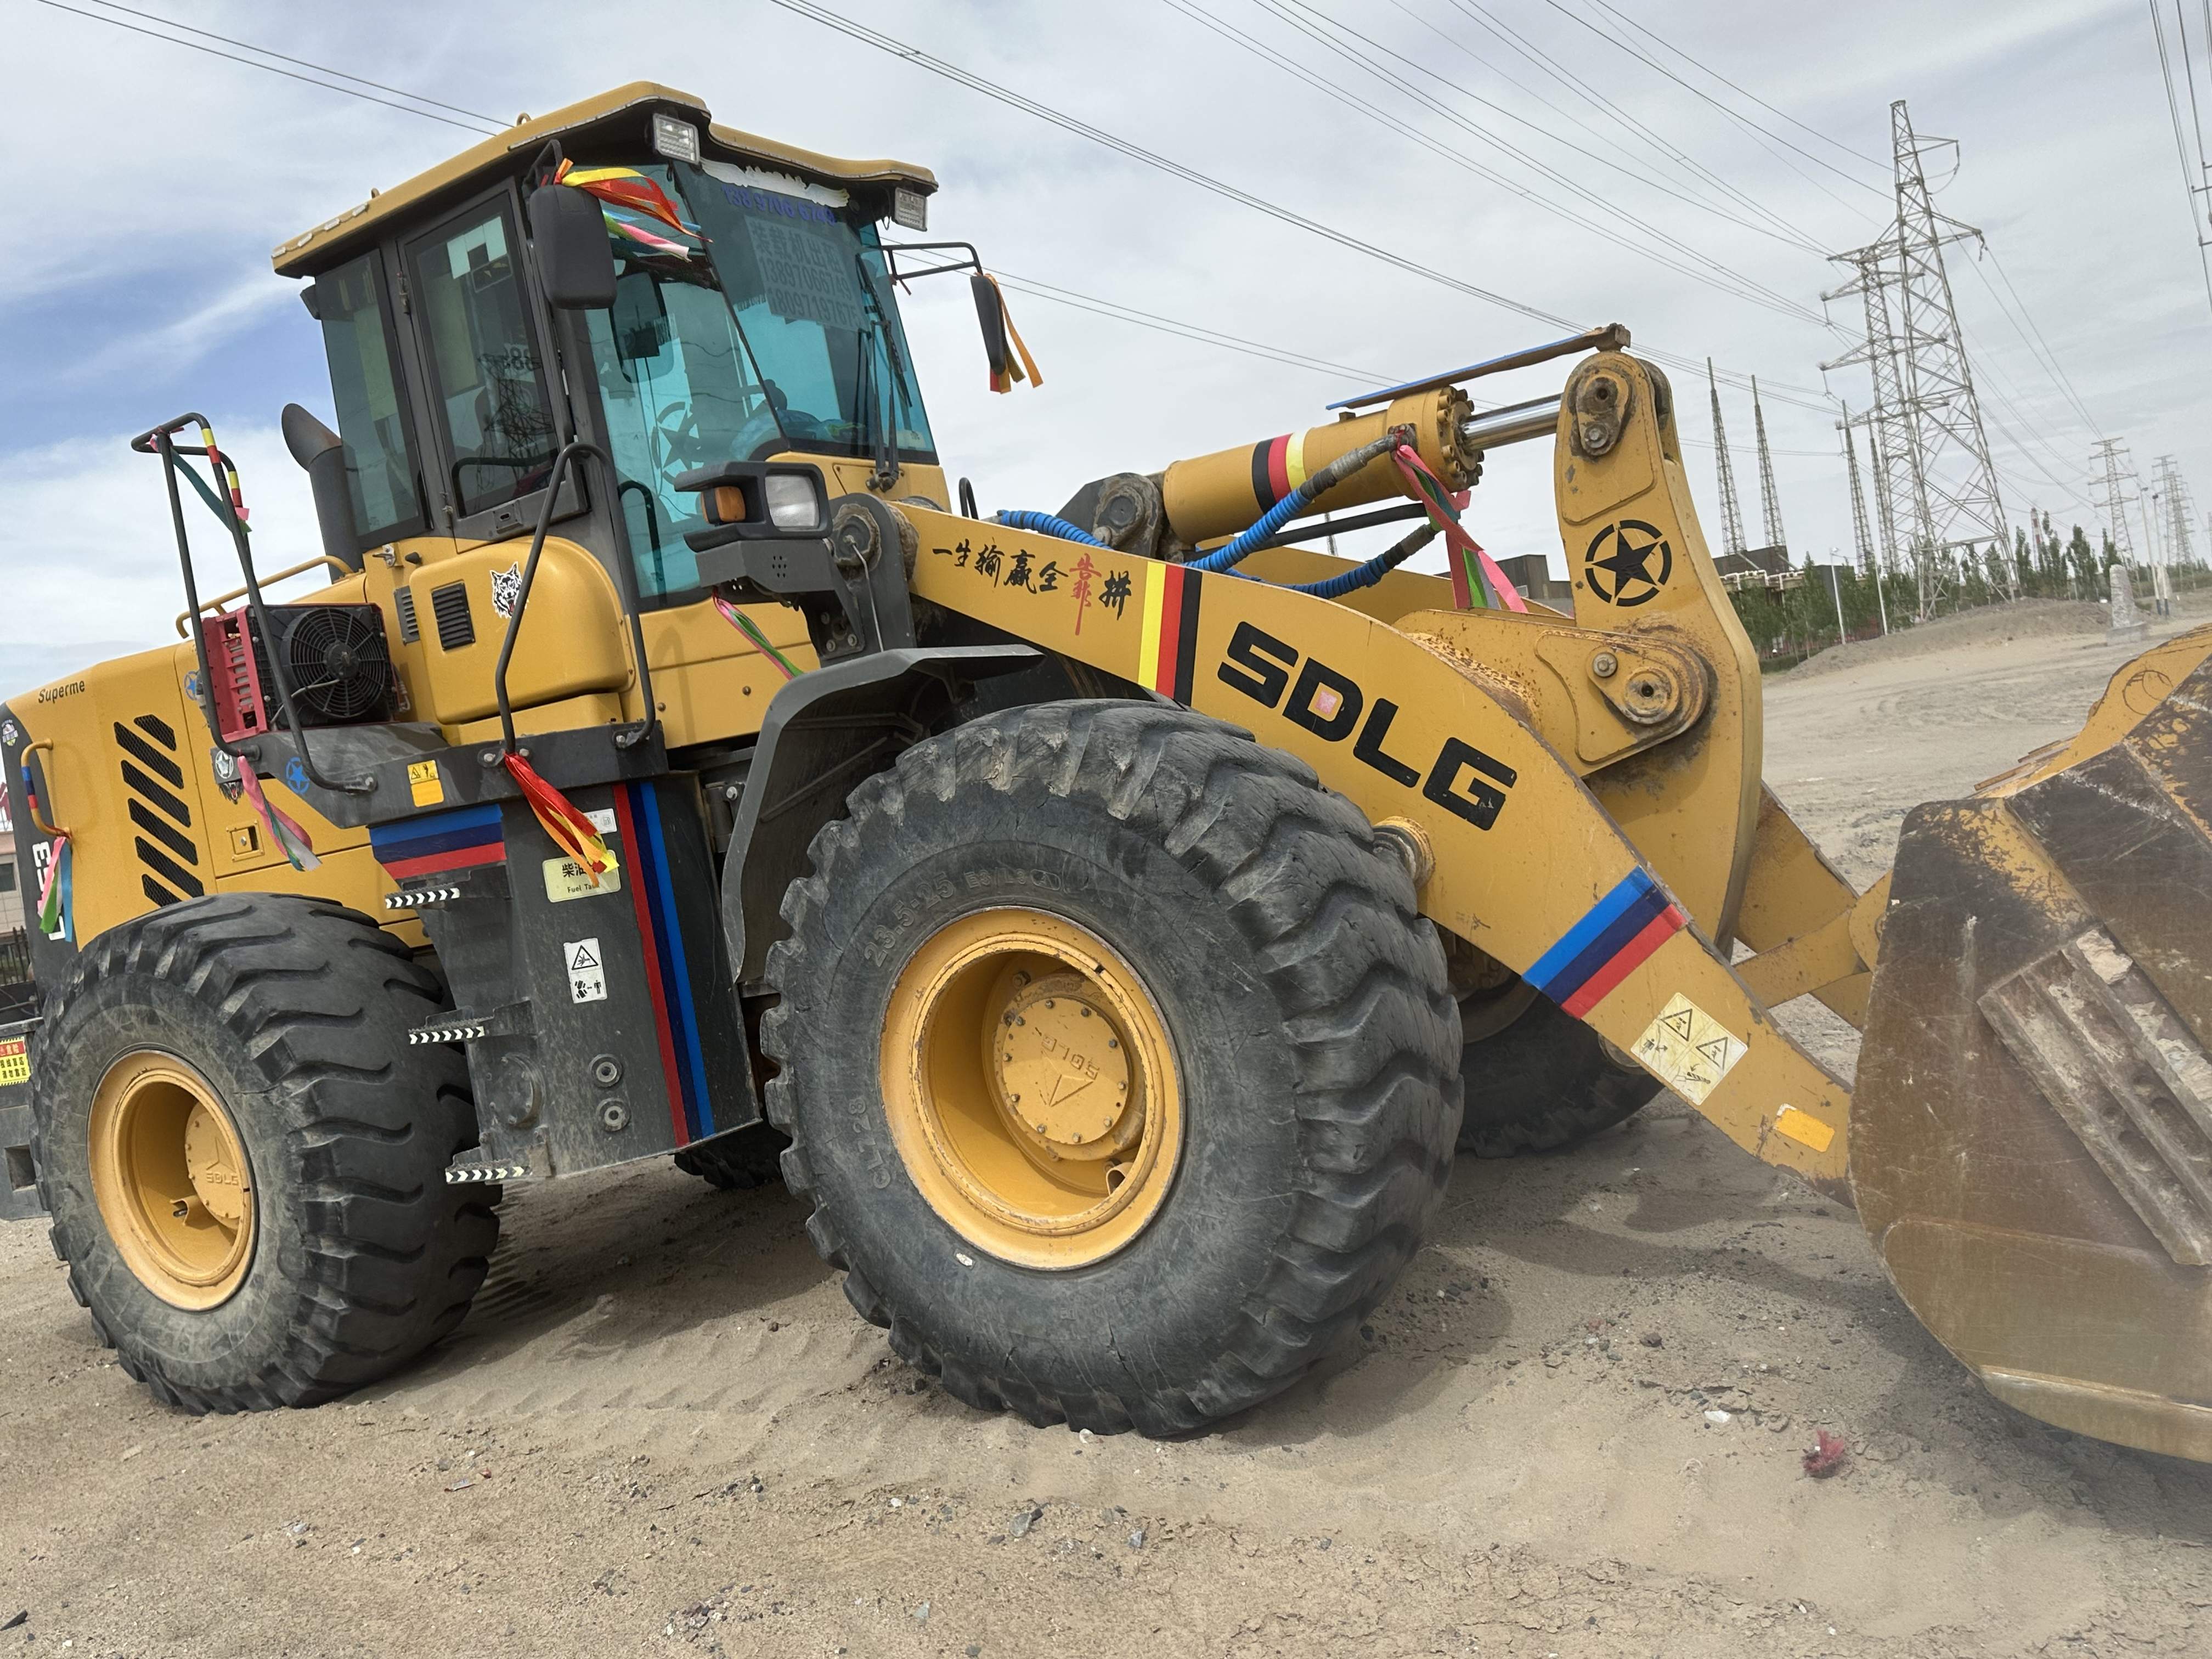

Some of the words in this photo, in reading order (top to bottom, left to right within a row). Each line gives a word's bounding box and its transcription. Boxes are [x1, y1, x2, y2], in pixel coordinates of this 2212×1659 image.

[721, 185, 753, 208] 138
[38, 680, 86, 704] Superme
[1217, 621, 1517, 831] SDLG
[562, 861, 596, 878] 柴油
[567, 885, 582, 893] Fuel
[1040, 1034, 1100, 1081] SDLG
